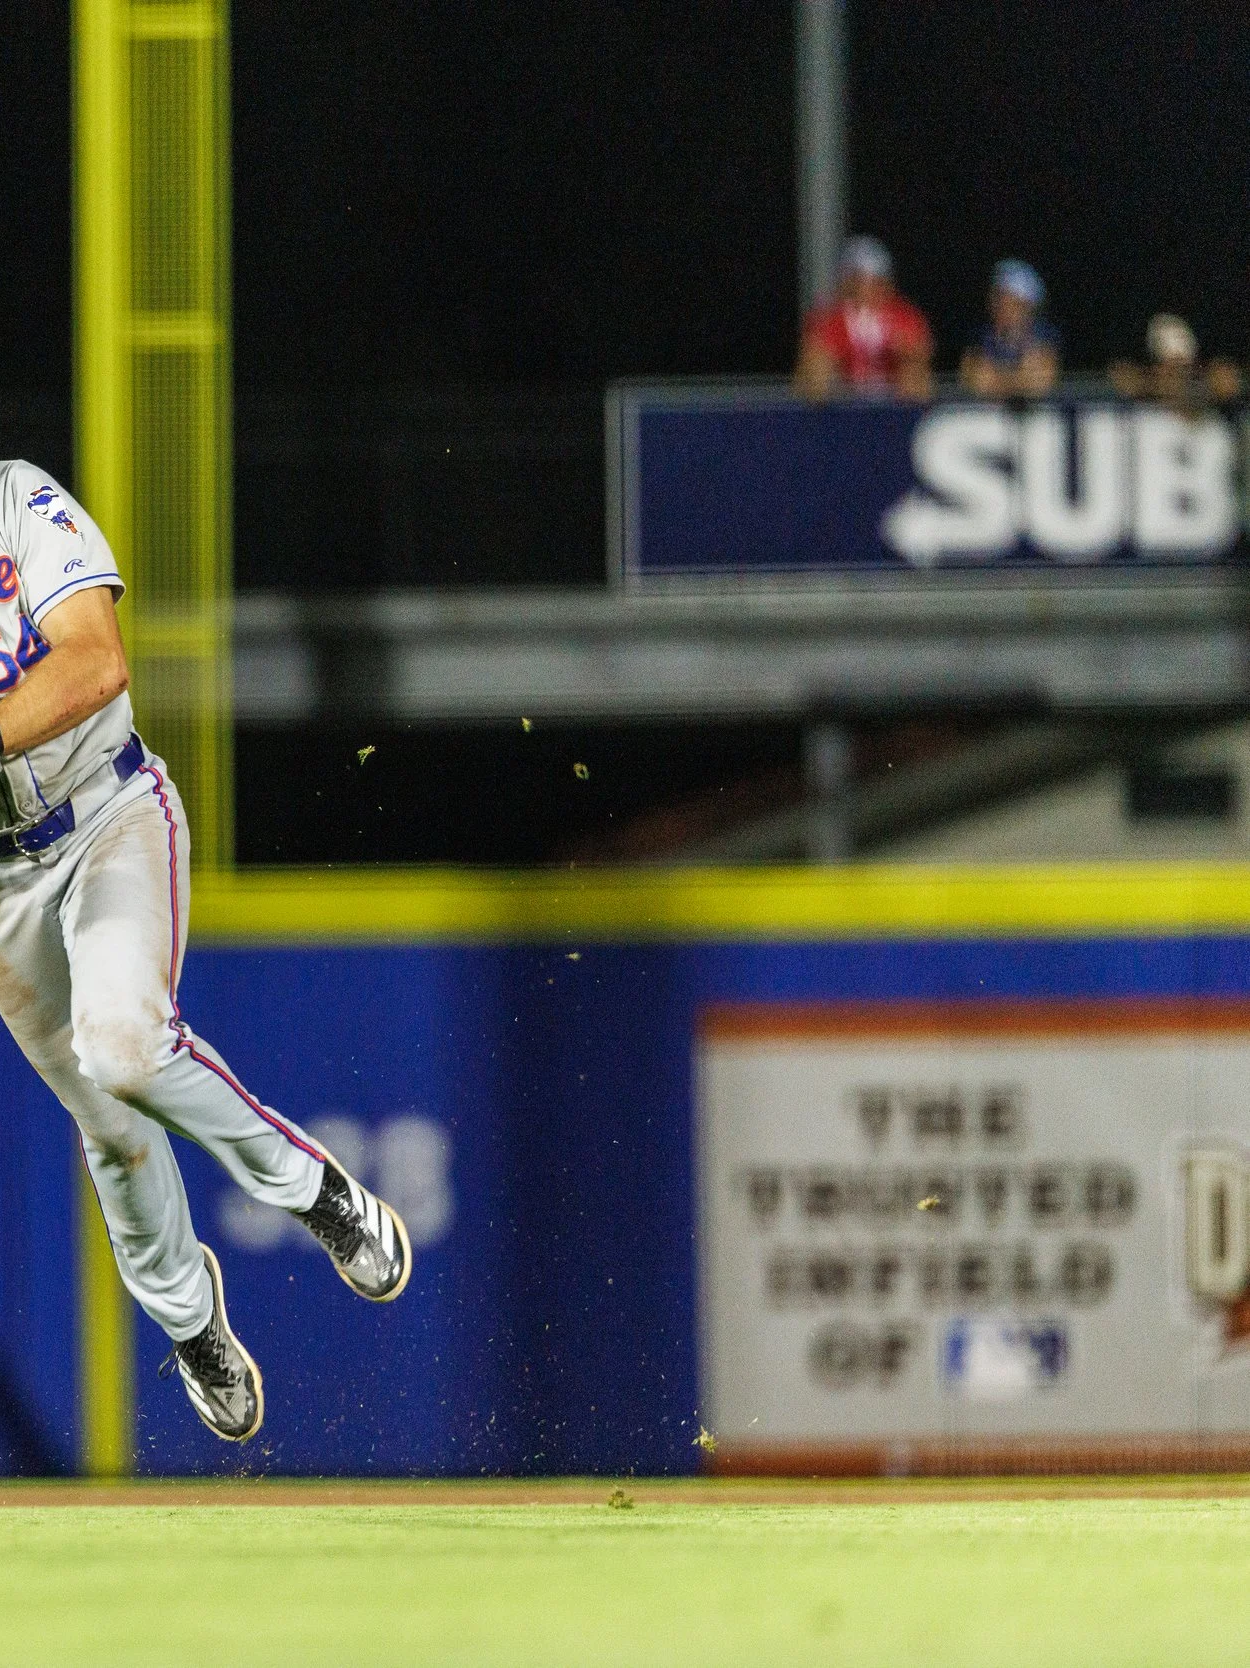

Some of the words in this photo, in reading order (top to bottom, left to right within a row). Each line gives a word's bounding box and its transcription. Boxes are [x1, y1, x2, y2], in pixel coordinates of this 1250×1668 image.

[853, 1086, 1023, 1146] THE
[738, 1166, 1139, 1230] TRUSTED
[762, 1243, 1118, 1312] INFIELD
[806, 1320, 918, 1390] OF
